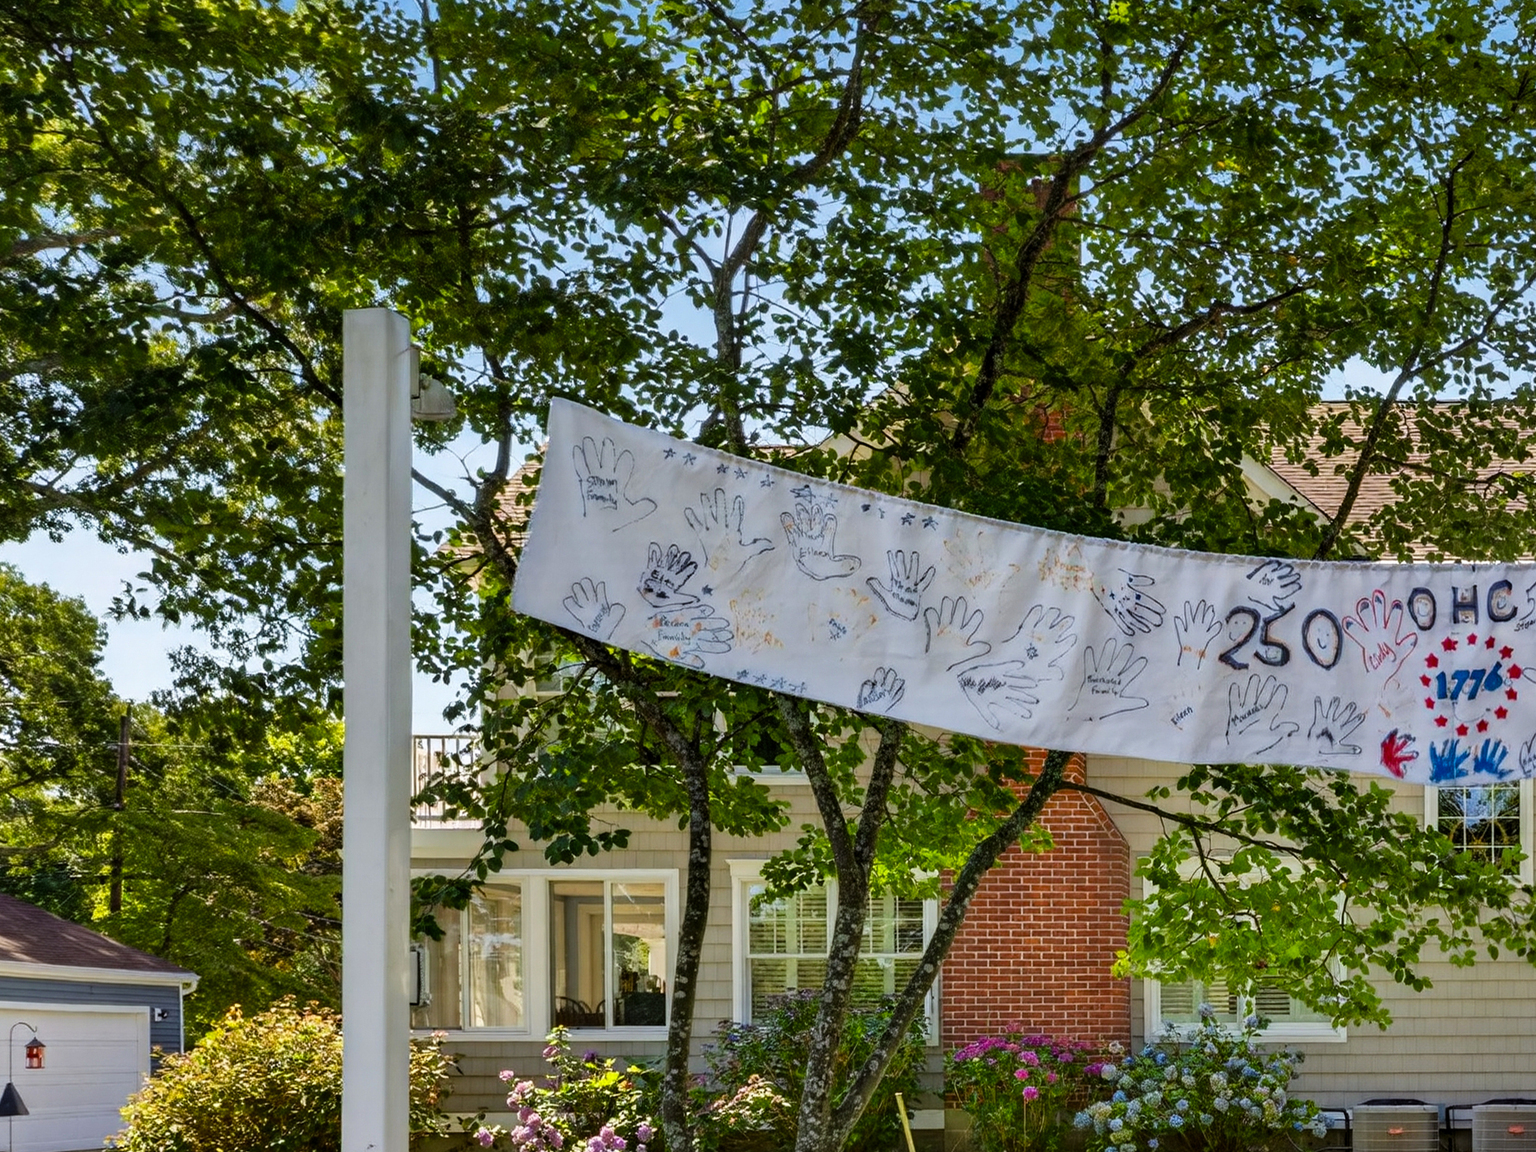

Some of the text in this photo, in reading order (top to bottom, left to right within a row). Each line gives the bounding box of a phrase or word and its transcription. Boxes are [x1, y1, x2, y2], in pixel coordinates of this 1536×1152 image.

[1218, 602, 1343, 671] 250
[1407, 579, 1518, 631] OHC
[1435, 661, 1503, 701] 1776
